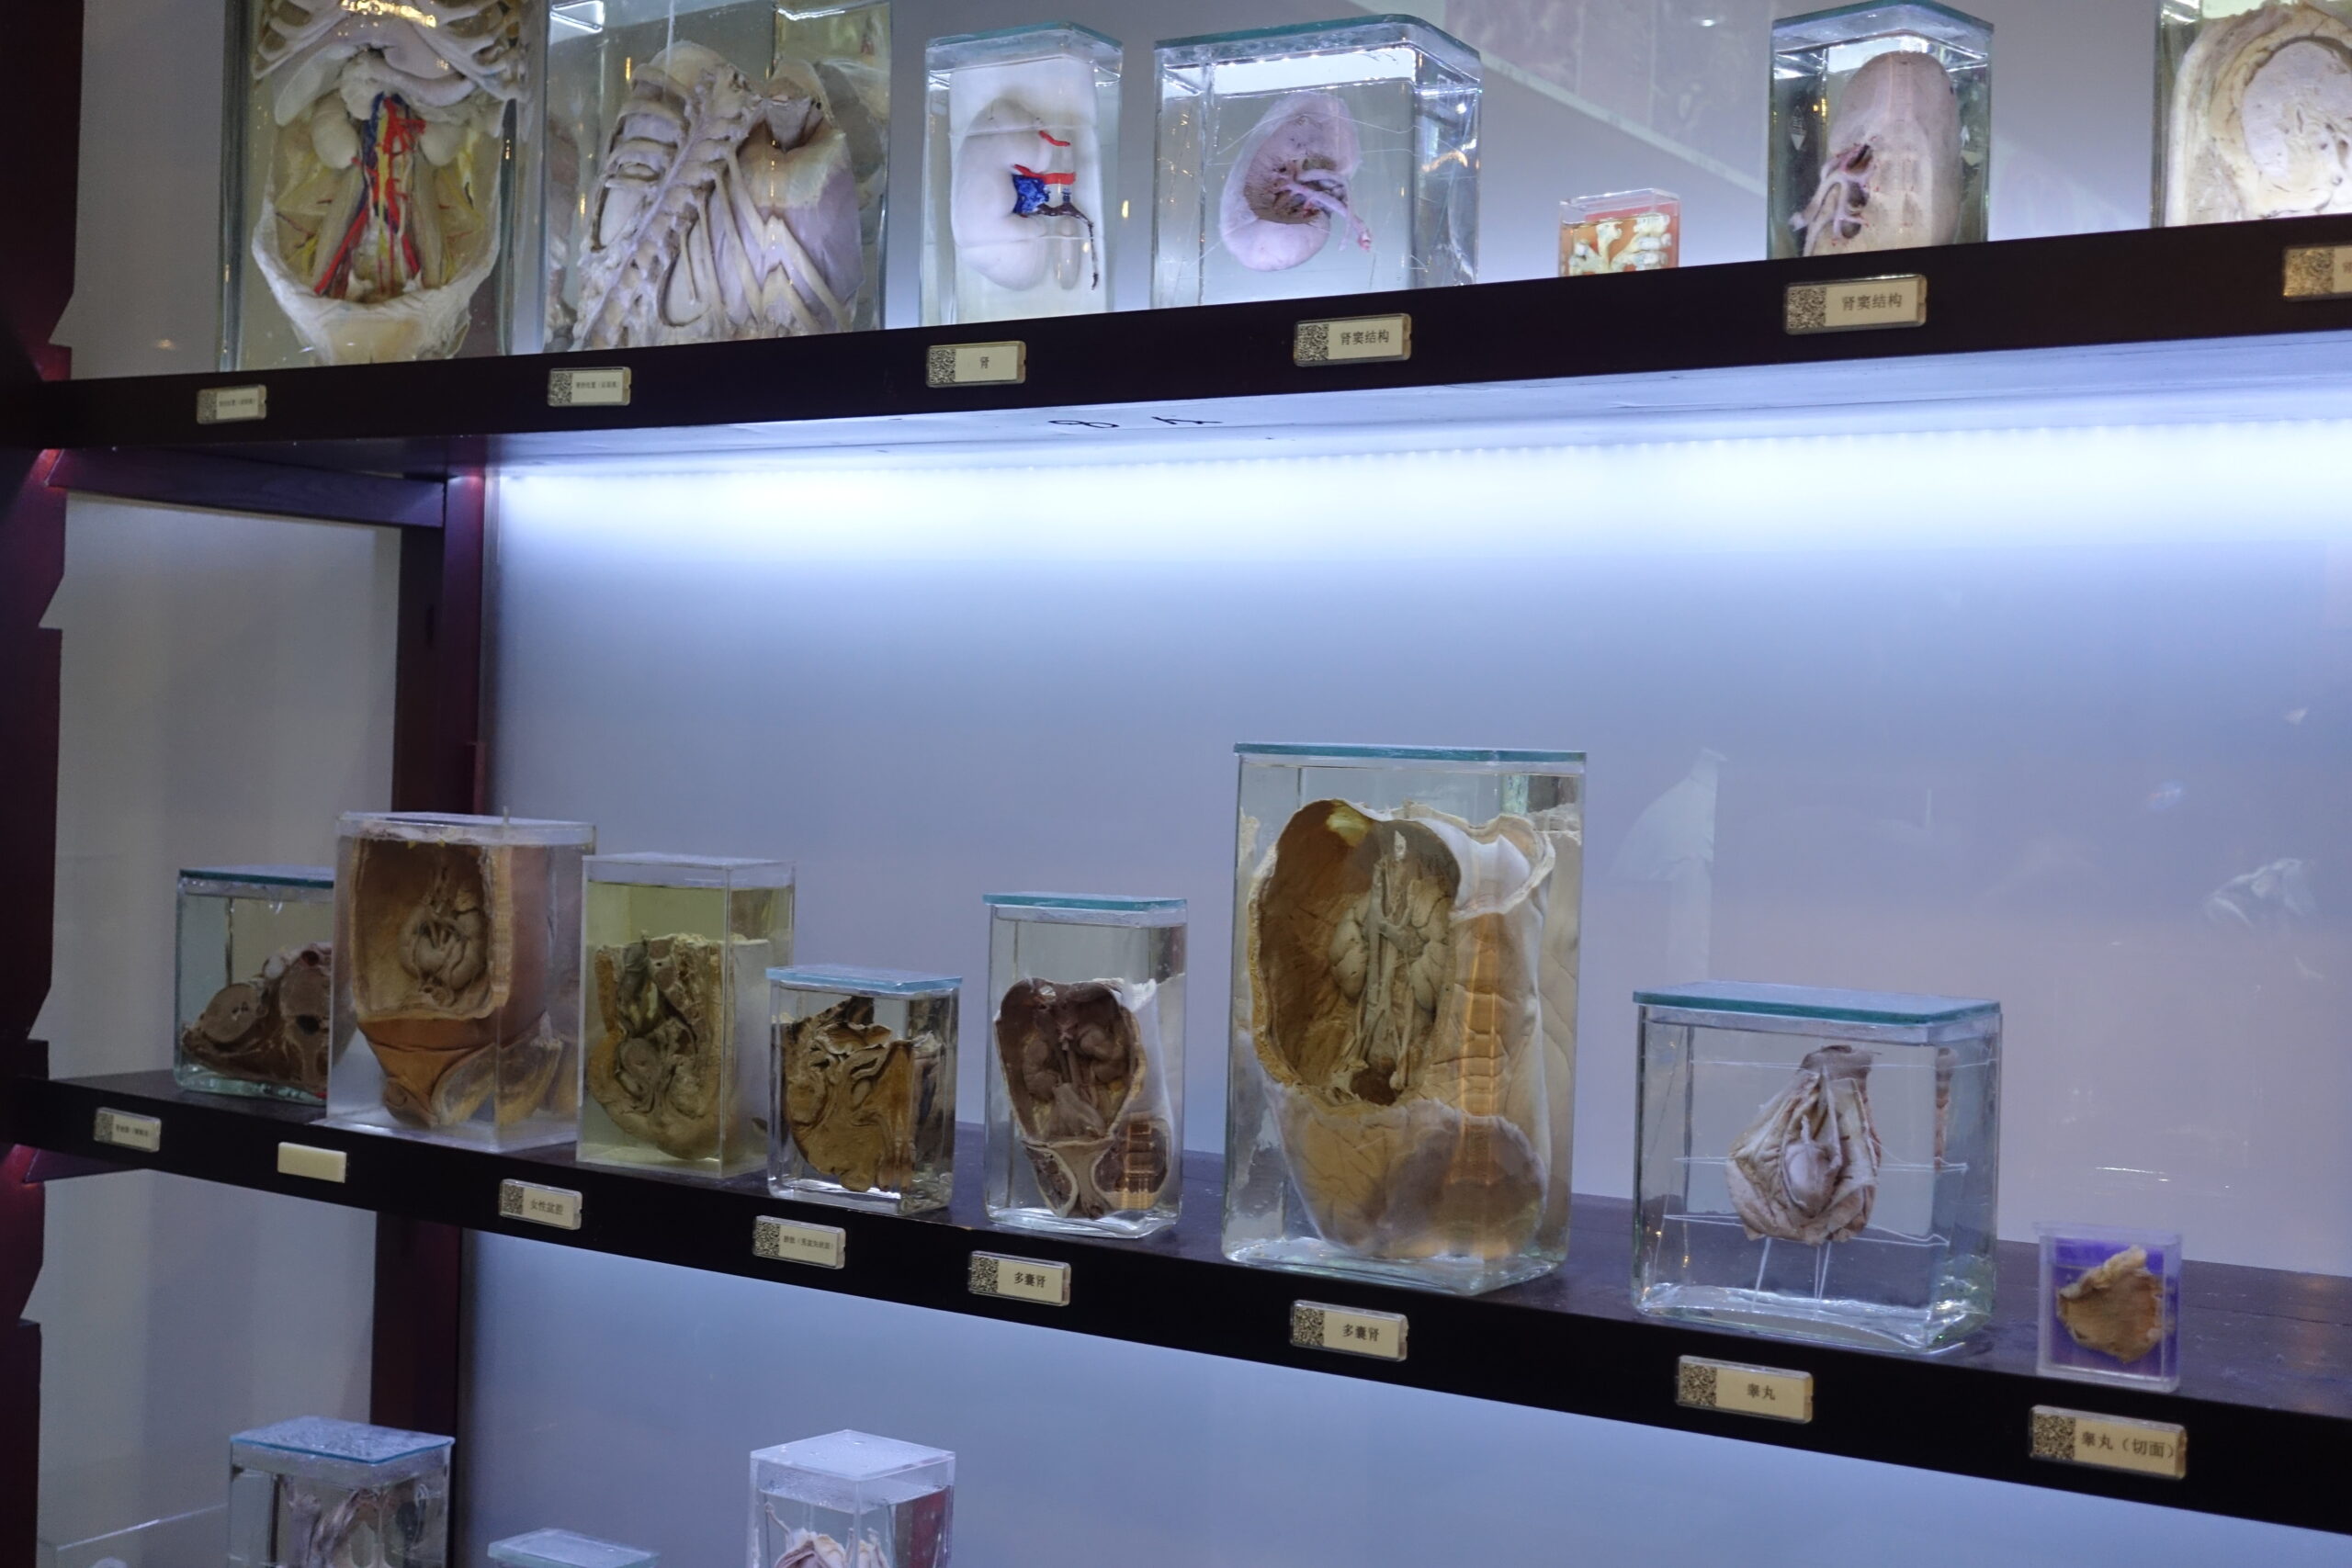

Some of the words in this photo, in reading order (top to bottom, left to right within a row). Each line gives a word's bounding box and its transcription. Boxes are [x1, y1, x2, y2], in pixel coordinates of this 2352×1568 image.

[1840, 293, 1901, 311] 肾窦结构
[1340, 330, 1389, 346] 肾窦结构
[979, 356, 989, 369] 肾
[1013, 1271, 1046, 1288] 多囊肾
[1342, 1324, 1380, 1342] 多囊肾
[1747, 1383, 1776, 1401] 睾丸
[2081, 1431, 2174, 1458] 睾丸（切面）
